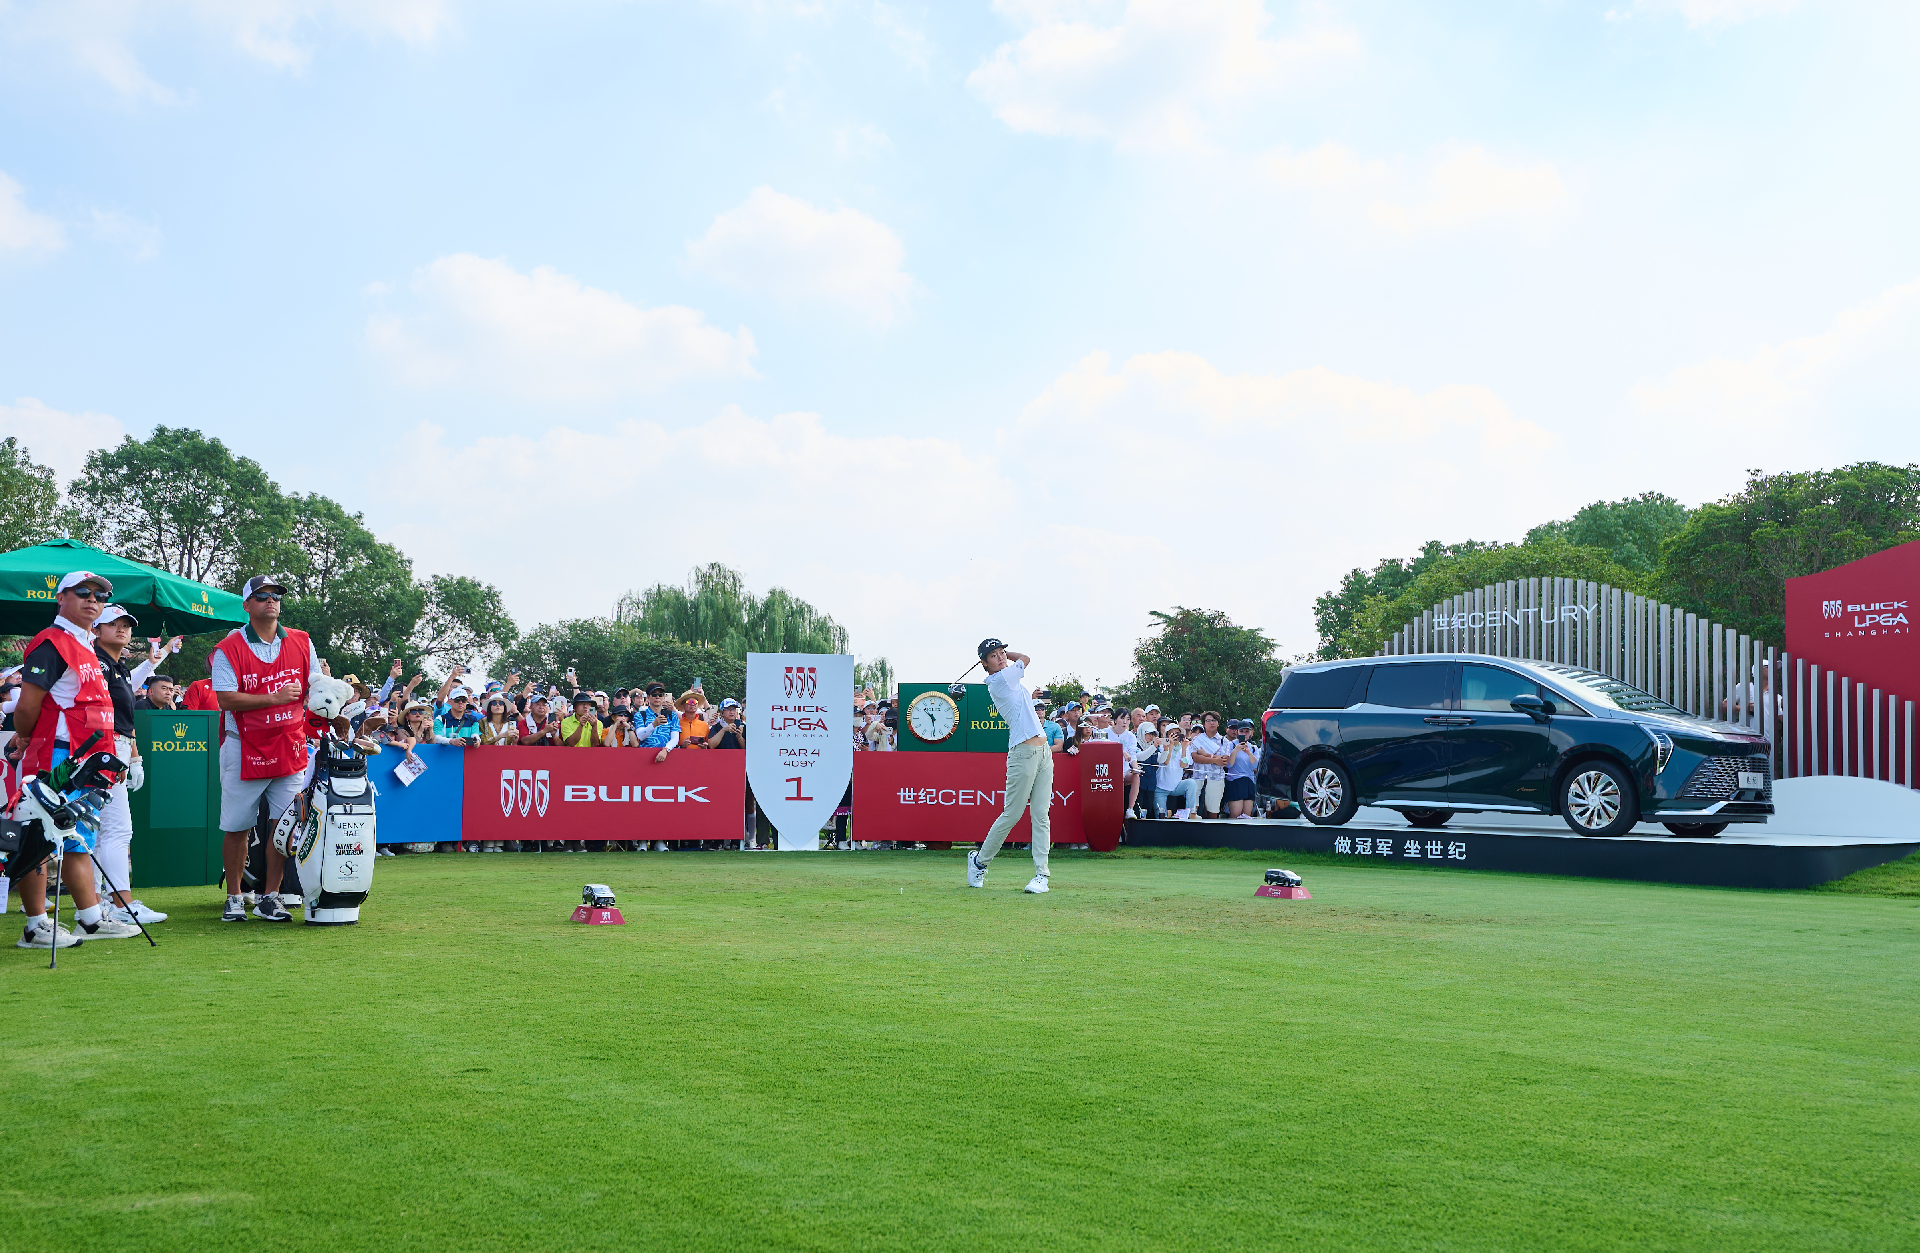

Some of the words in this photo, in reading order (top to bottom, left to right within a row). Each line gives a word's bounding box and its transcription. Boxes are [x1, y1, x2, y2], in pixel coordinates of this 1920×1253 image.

[26, 590, 56, 600] ROL
[1847, 601, 1909, 612] BUICK
[1854, 612, 1909, 628] LPGA
[1824, 627, 1909, 638] SHANGHAI
[261, 668, 301, 684] BUICK
[265, 715, 270, 724] J
[274, 710, 293, 722] BAE
[771, 717, 828, 731] LPGA
[970, 720, 1010, 730] ROLE
[151, 741, 208, 752] ROLEX
[779, 749, 808, 757] PAR
[811, 749, 820, 757] 4
[564, 785, 711, 803] BUICK
[785, 777, 813, 801] 1
[337, 822, 365, 830] JENNY
[1334, 835, 1394, 857] 做冠军
[1403, 839, 1467, 861] 坐世纪
